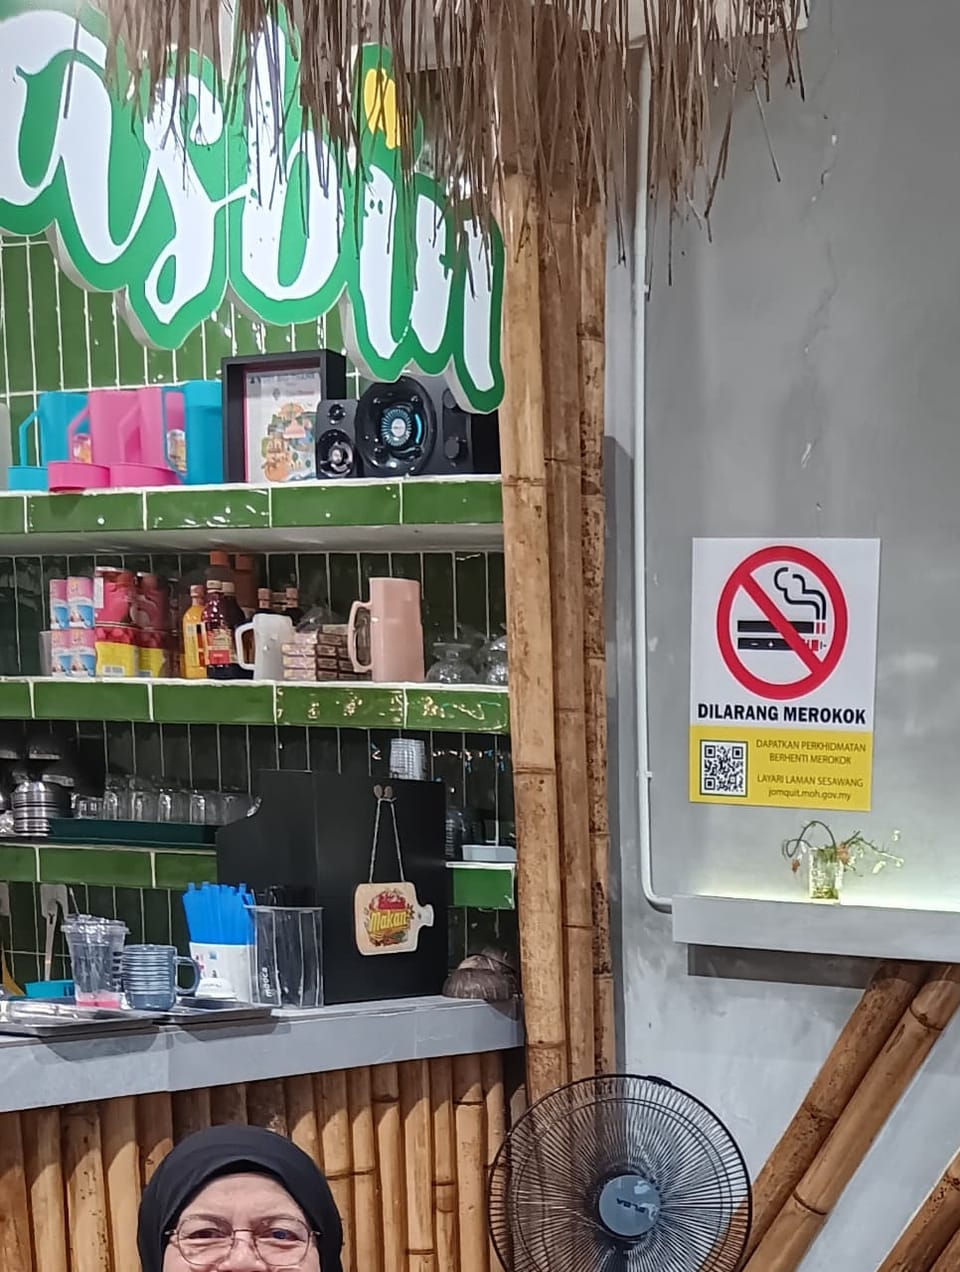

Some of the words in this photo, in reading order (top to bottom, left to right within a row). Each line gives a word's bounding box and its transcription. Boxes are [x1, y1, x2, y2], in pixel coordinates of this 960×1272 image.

[698, 703, 779, 721] DILARANG
[783, 706, 866, 725] MEROKOK
[756, 739, 799, 750] DAPATKAN
[801, 741, 867, 753] PERKHIDMATAN
[769, 752, 809, 763] BERHENTI
[810, 755, 852, 765] MEROKOK
[757, 774, 785, 784] LAYARI
[785, 775, 816, 786] LAMAN
[817, 777, 864, 788] SESAWANG
[768, 788, 852, 802] jomquit.moh.gov.my
[368, 911, 406, 932] Makan
